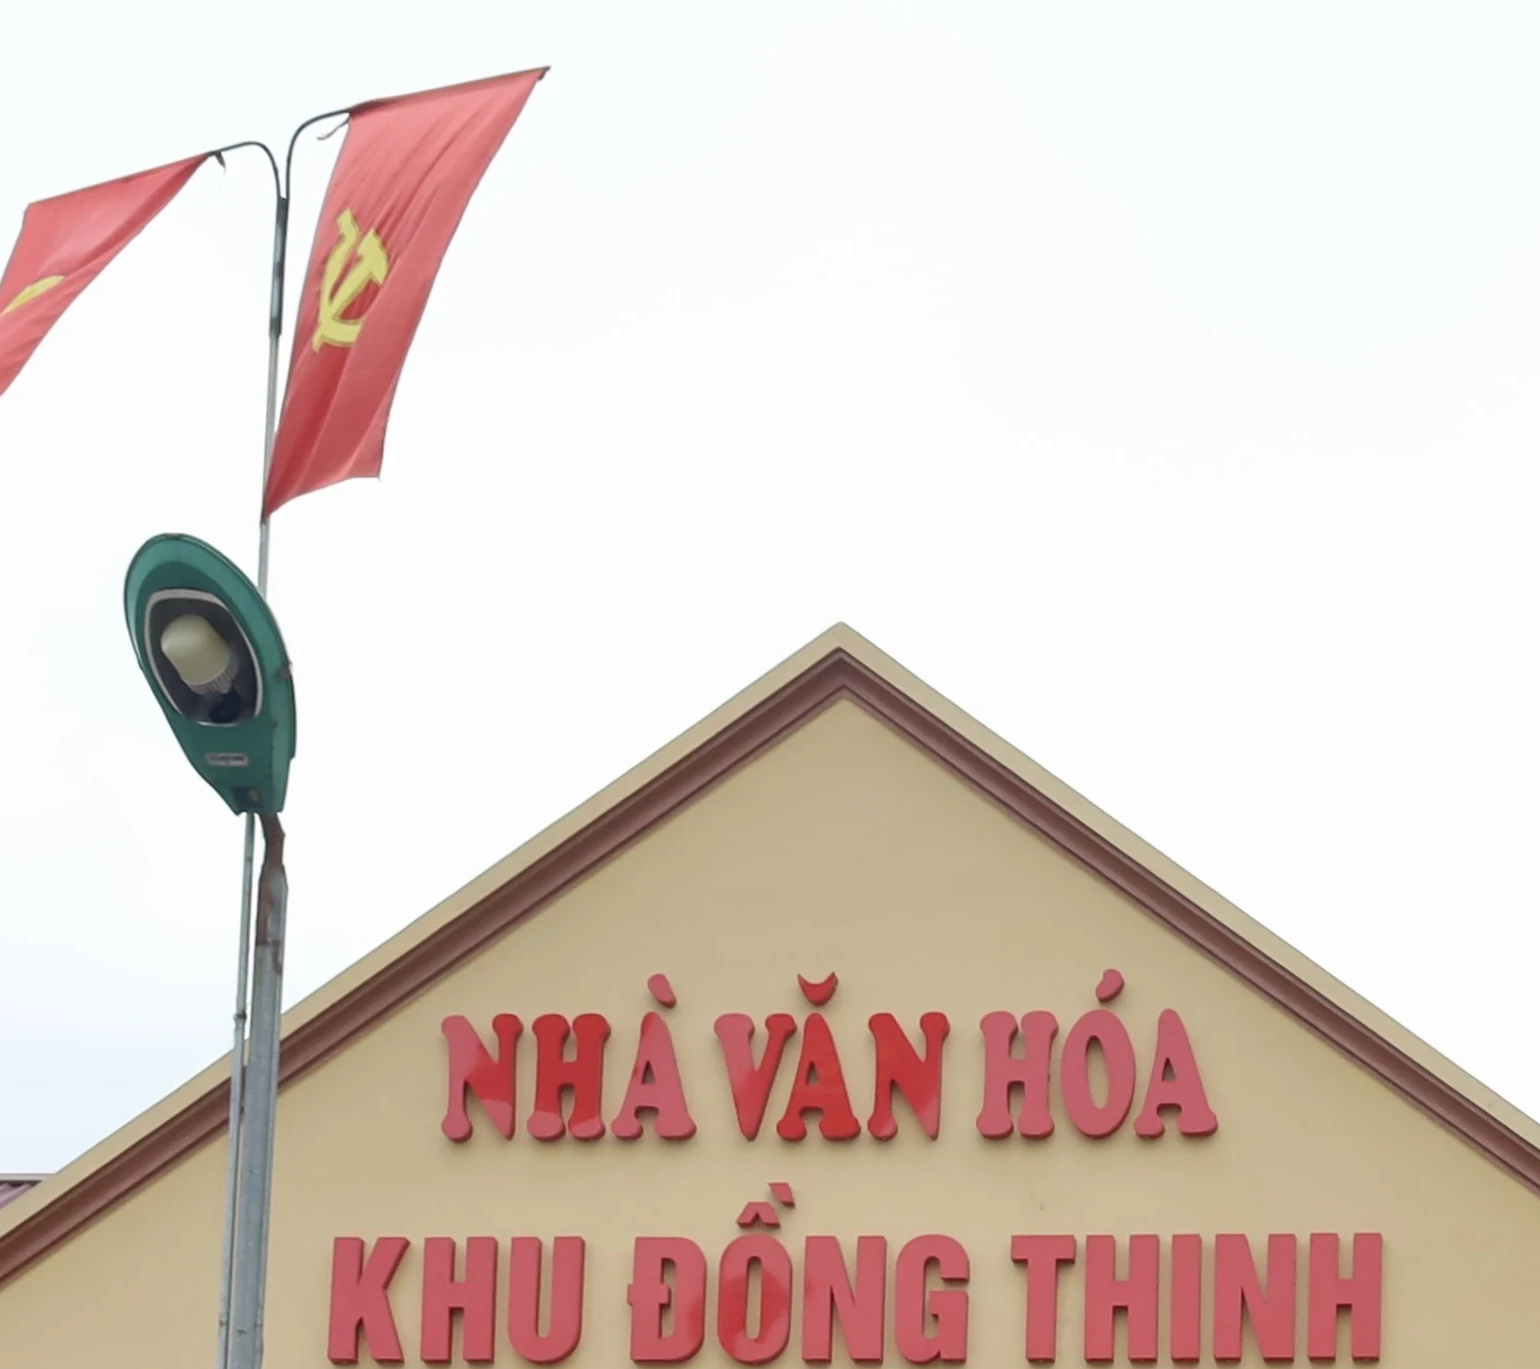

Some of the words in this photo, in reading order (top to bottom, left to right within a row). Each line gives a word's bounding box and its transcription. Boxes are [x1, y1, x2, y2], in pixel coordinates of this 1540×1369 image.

[441, 972, 698, 1142] NHÀ
[713, 972, 951, 1142] VĂN
[975, 968, 1218, 1140] HÓA
[327, 1236, 586, 1365] KHU
[627, 1182, 970, 1365] ĐỒNG
